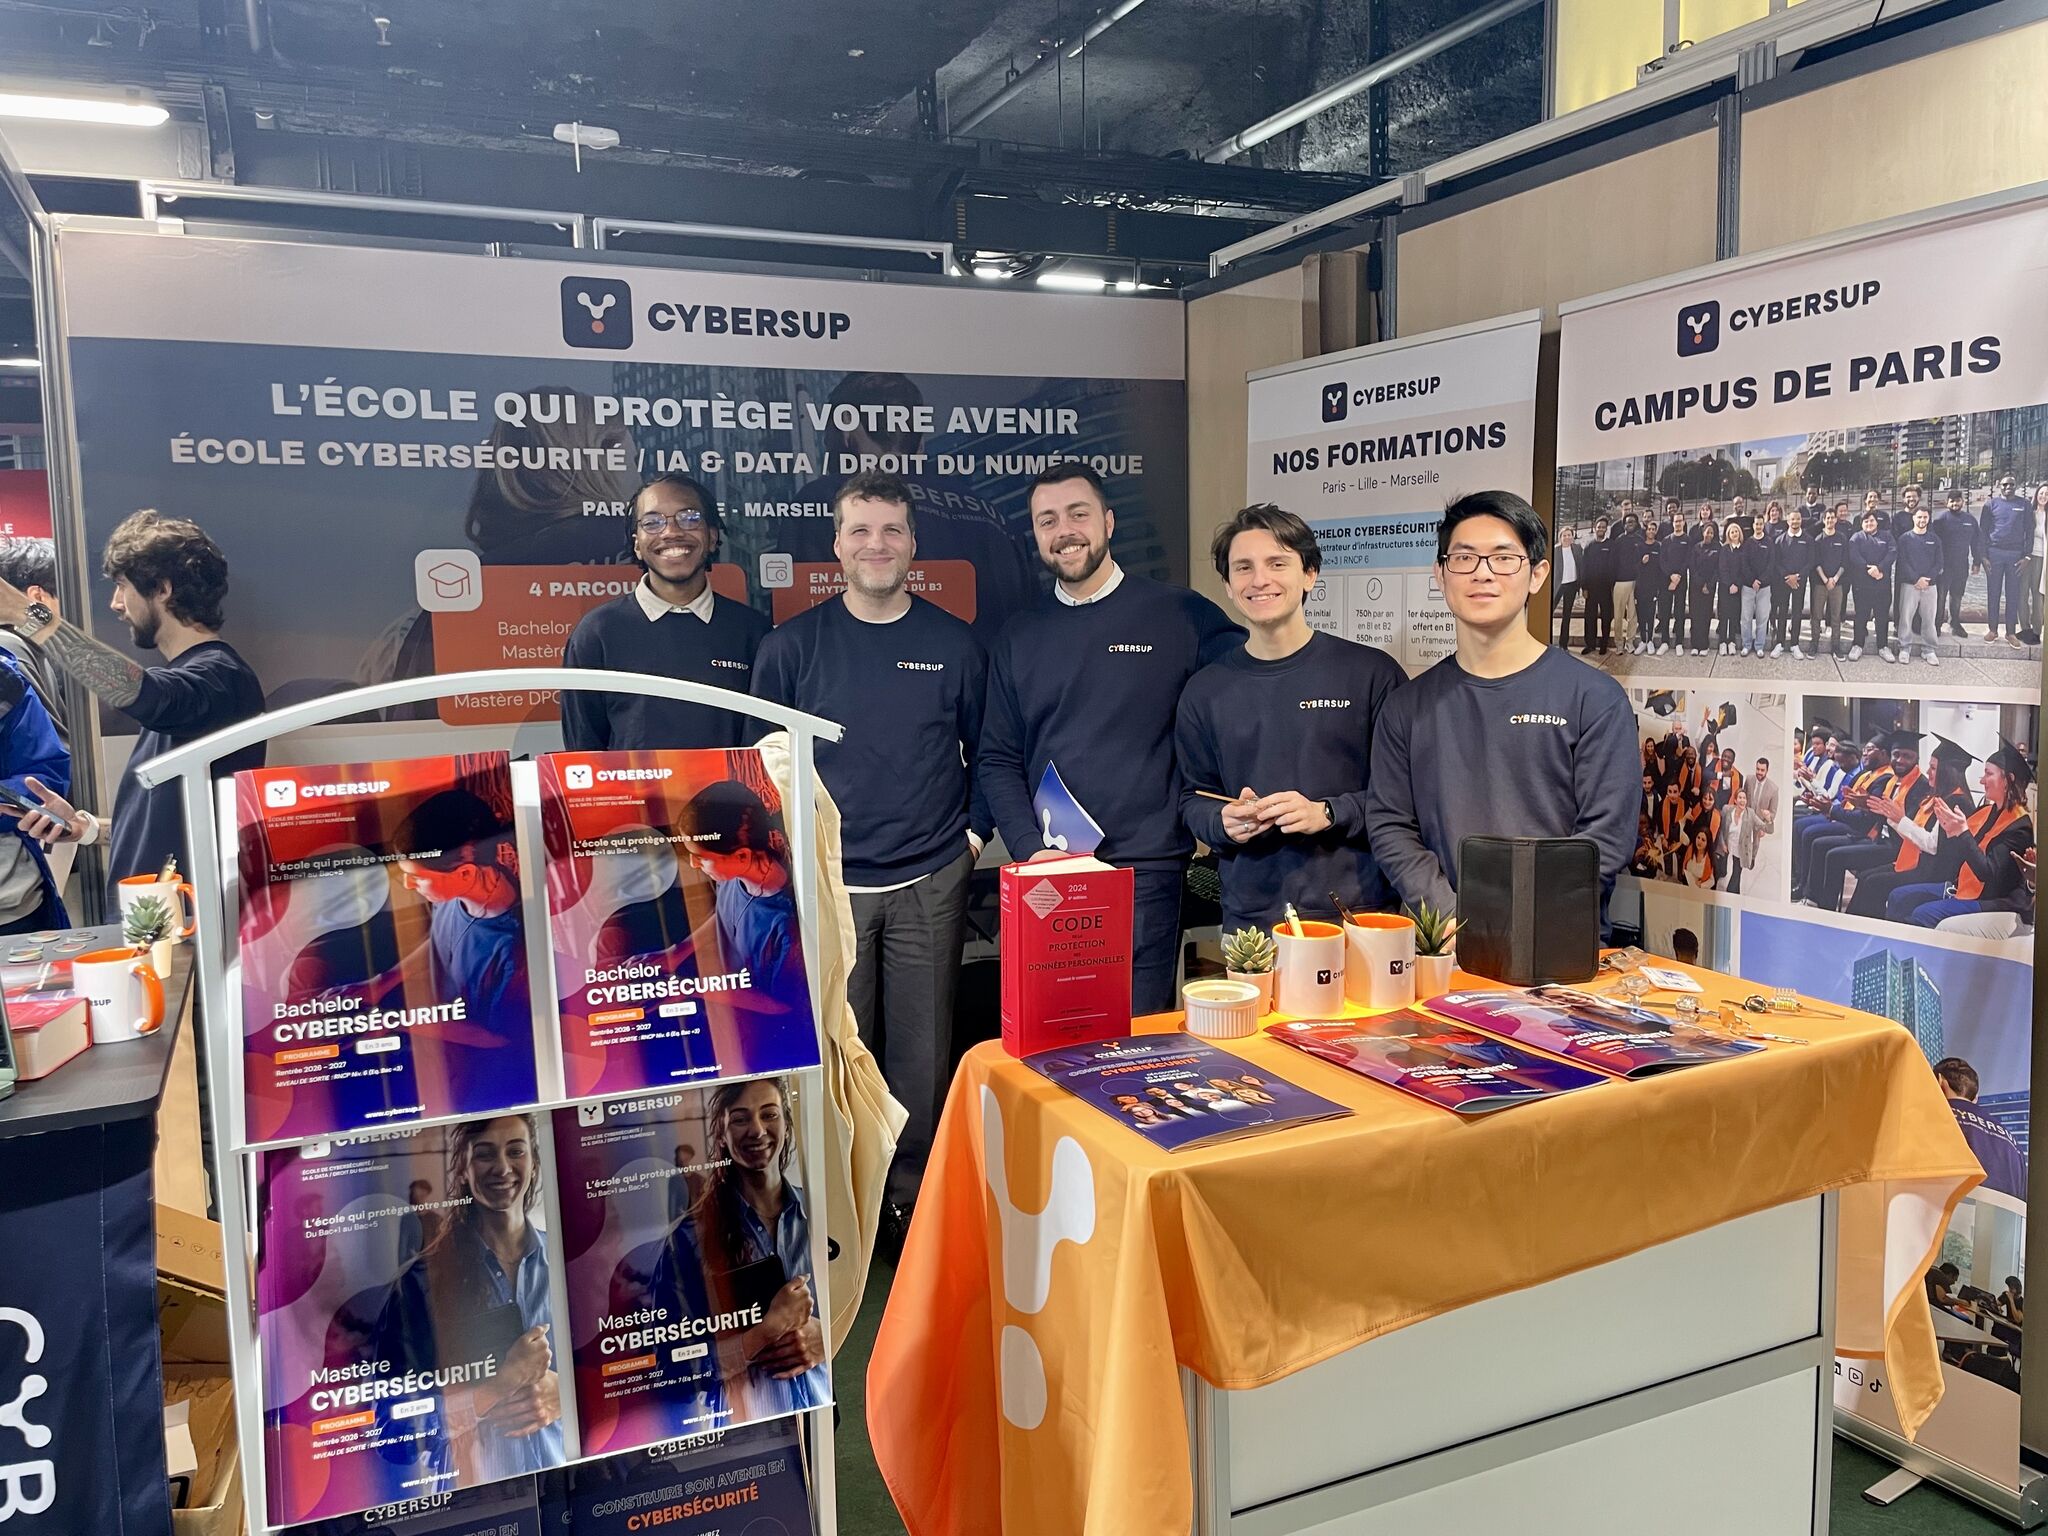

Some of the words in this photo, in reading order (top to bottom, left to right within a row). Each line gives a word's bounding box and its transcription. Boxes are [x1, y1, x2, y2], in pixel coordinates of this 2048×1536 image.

[1729, 280, 1880, 331] CYBERSUP
[648, 302, 851, 340] CYBERSUP
[1353, 376, 1441, 406] CYBERSUP
[1595, 376, 1757, 431] CAMPUS
[1774, 363, 1831, 403] DE
[1849, 335, 2001, 392] PARIS
[271, 377, 479, 421] L'ÉCOLE
[494, 391, 577, 428] QUI
[594, 393, 793, 430] PROTÈGE
[806, 403, 934, 433] VOTRE
[947, 407, 1078, 435] AVENIR
[170, 432, 305, 465] ÉCOLE
[318, 440, 626, 472] CYBERSÉCURITÉ
[657, 450, 690, 473] IA
[701, 450, 724, 473] &
[735, 452, 813, 474] DATA
[839, 453, 927, 475] DROIT
[938, 454, 975, 475] DU
[1273, 448, 1319, 475] NOS
[1328, 422, 1506, 468] FORMATIONS
[1322, 479, 1346, 494] Paris
[1358, 477, 1378, 491] Lille
[1391, 471, 1440, 487] Marseille
[583, 501, 627, 516] PAR
[745, 503, 834, 517] MARSEIL
[904, 483, 1006, 525] BERSU
[1313, 528, 1351, 539] CHELOR
[1317, 543, 1350, 552] istrateur
[1415, 537, 1438, 548] sécur
[1322, 557, 1338, 566] ac+3
[1344, 555, 1363, 564] RNCP
[810, 573, 828, 583] EN
[529, 582, 543, 596] 4
[550, 581, 636, 597] PARCOU
[911, 583, 926, 592] DU
[929, 583, 942, 591] B3
[1305, 609, 1312, 617] En
[1313, 609, 1331, 617] initial
[1355, 609, 1372, 617] 750h
[1373, 610, 1385, 619] par
[1420, 608, 1455, 620] équipem
[498, 621, 572, 636] Bachelor
[1413, 623, 1433, 631] offert
[1356, 634, 1373, 642] 550h
[1422, 636, 1455, 645] Framewor
[1108, 644, 1153, 653] CYBERSUP
[711, 659, 749, 670] CYBERSUP
[897, 661, 944, 671] CYBERSUP
[455, 692, 523, 708] Mastère
[1299, 699, 1350, 709] CYBERSUP
[1510, 713, 1567, 727] CYBERSUP
[597, 768, 673, 781] CYBERSUP
[301, 781, 390, 798] CYBERSUP
[610, 837, 626, 847] qui
[628, 835, 664, 847] protège
[666, 835, 691, 843] votre
[693, 832, 721, 842] avenir
[313, 858, 331, 869] qui
[333, 855, 376, 868] protège
[379, 853, 406, 863] votre
[409, 849, 442, 860] avenir
[1068, 884, 1087, 892] 2024
[1053, 915, 1103, 932] CODE
[1049, 940, 1105, 951] PROTECTION
[1028, 961, 1066, 972] DONNÉES
[1068, 955, 1125, 968] PERSONNELLES
[585, 963, 661, 984] Bachelor
[586, 968, 752, 1006] CYBERSÉCURITÉ
[274, 996, 363, 1019] Bachelor
[274, 998, 467, 1042] CYBERSÉCURITÉ
[608, 1095, 683, 1115] CYBERSUP
[1951, 1108, 2017, 1146] YBERSU
[623, 1172, 638, 1184] qui
[640, 1168, 677, 1181] protège
[678, 1164, 702, 1175] votre
[704, 1158, 732, 1169] avenir
[348, 1210, 366, 1222] qui
[368, 1205, 410, 1220] protège
[412, 1202, 439, 1213] votre
[442, 1196, 473, 1208] avenir
[305, 1230, 317, 1239] Du
[598, 1308, 668, 1332] Mastère
[600, 1302, 763, 1355] CYBERSÉCURITÉ
[311, 1360, 391, 1387] Mastère
[311, 1353, 497, 1412] CYBERSÉCURITÉ
[648, 1430, 725, 1457] CYBERSUP
[592, 1484, 683, 1518] CONSTRUIRE
[685, 1478, 715, 1495] SON
[717, 1466, 766, 1486] AVENIR
[768, 1459, 785, 1473] EN
[364, 1492, 453, 1522] CYBERSUP
[627, 1483, 759, 1532] CYBERSÉCURITÉ
